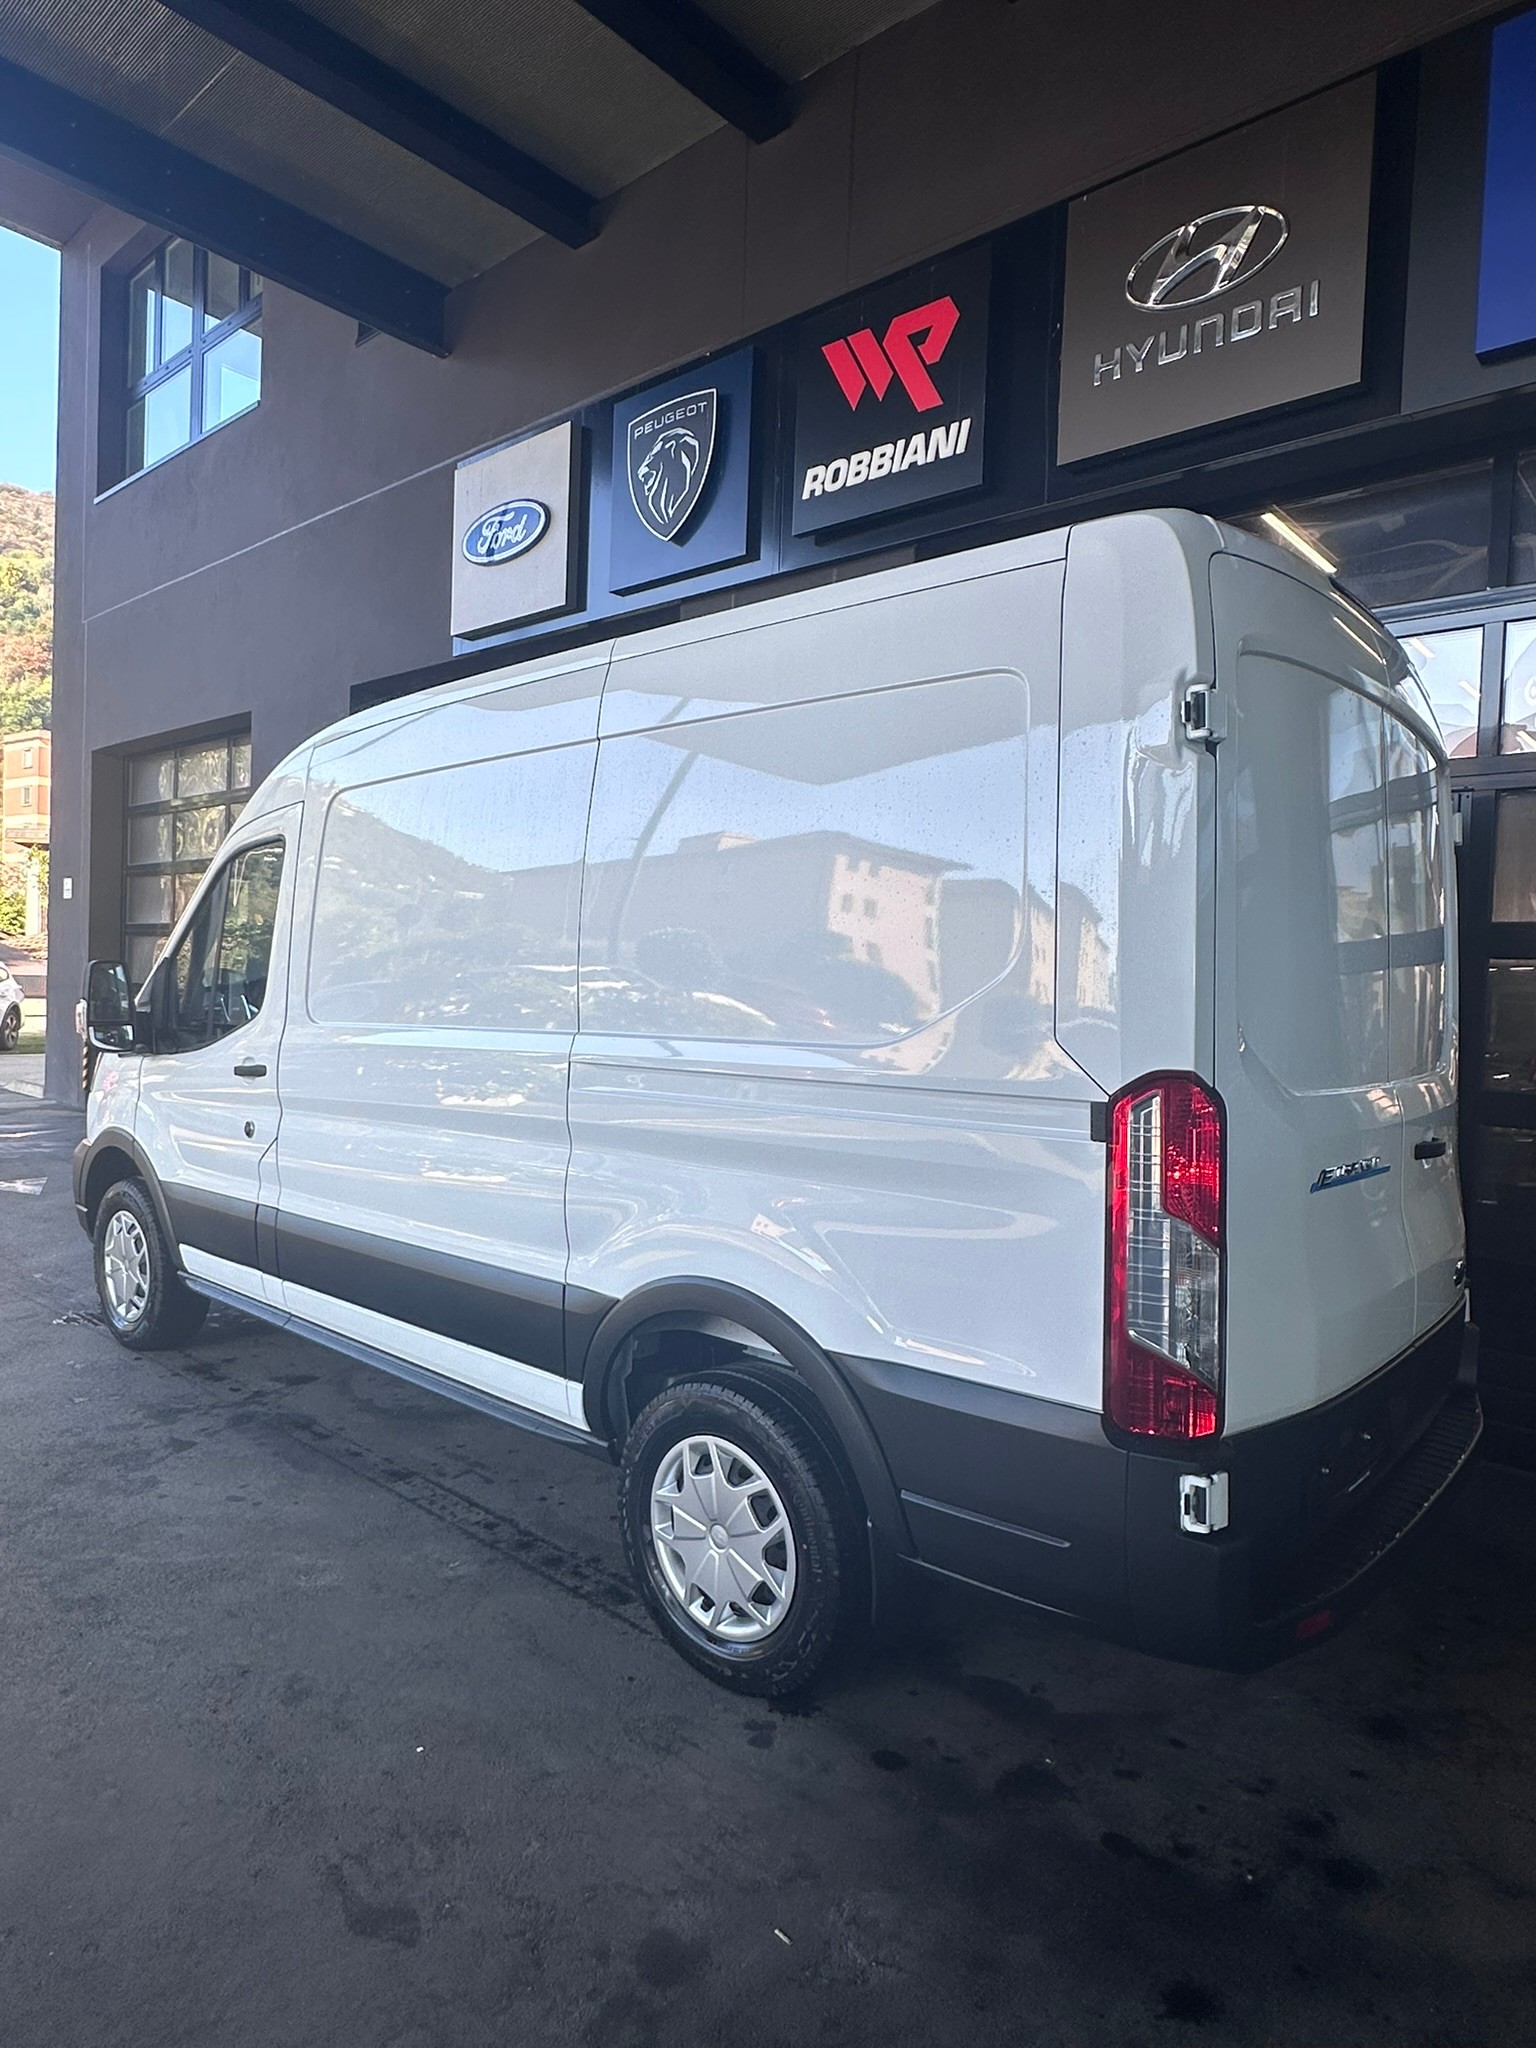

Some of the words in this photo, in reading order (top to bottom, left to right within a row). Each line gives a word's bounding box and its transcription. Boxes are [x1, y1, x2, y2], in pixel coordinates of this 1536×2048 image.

[1093, 279, 1321, 386] HYUNDAI
[634, 401, 708, 440] PEUGEOT
[801, 417, 972, 501] ROBBIANI
[477, 510, 529, 555] Ford
